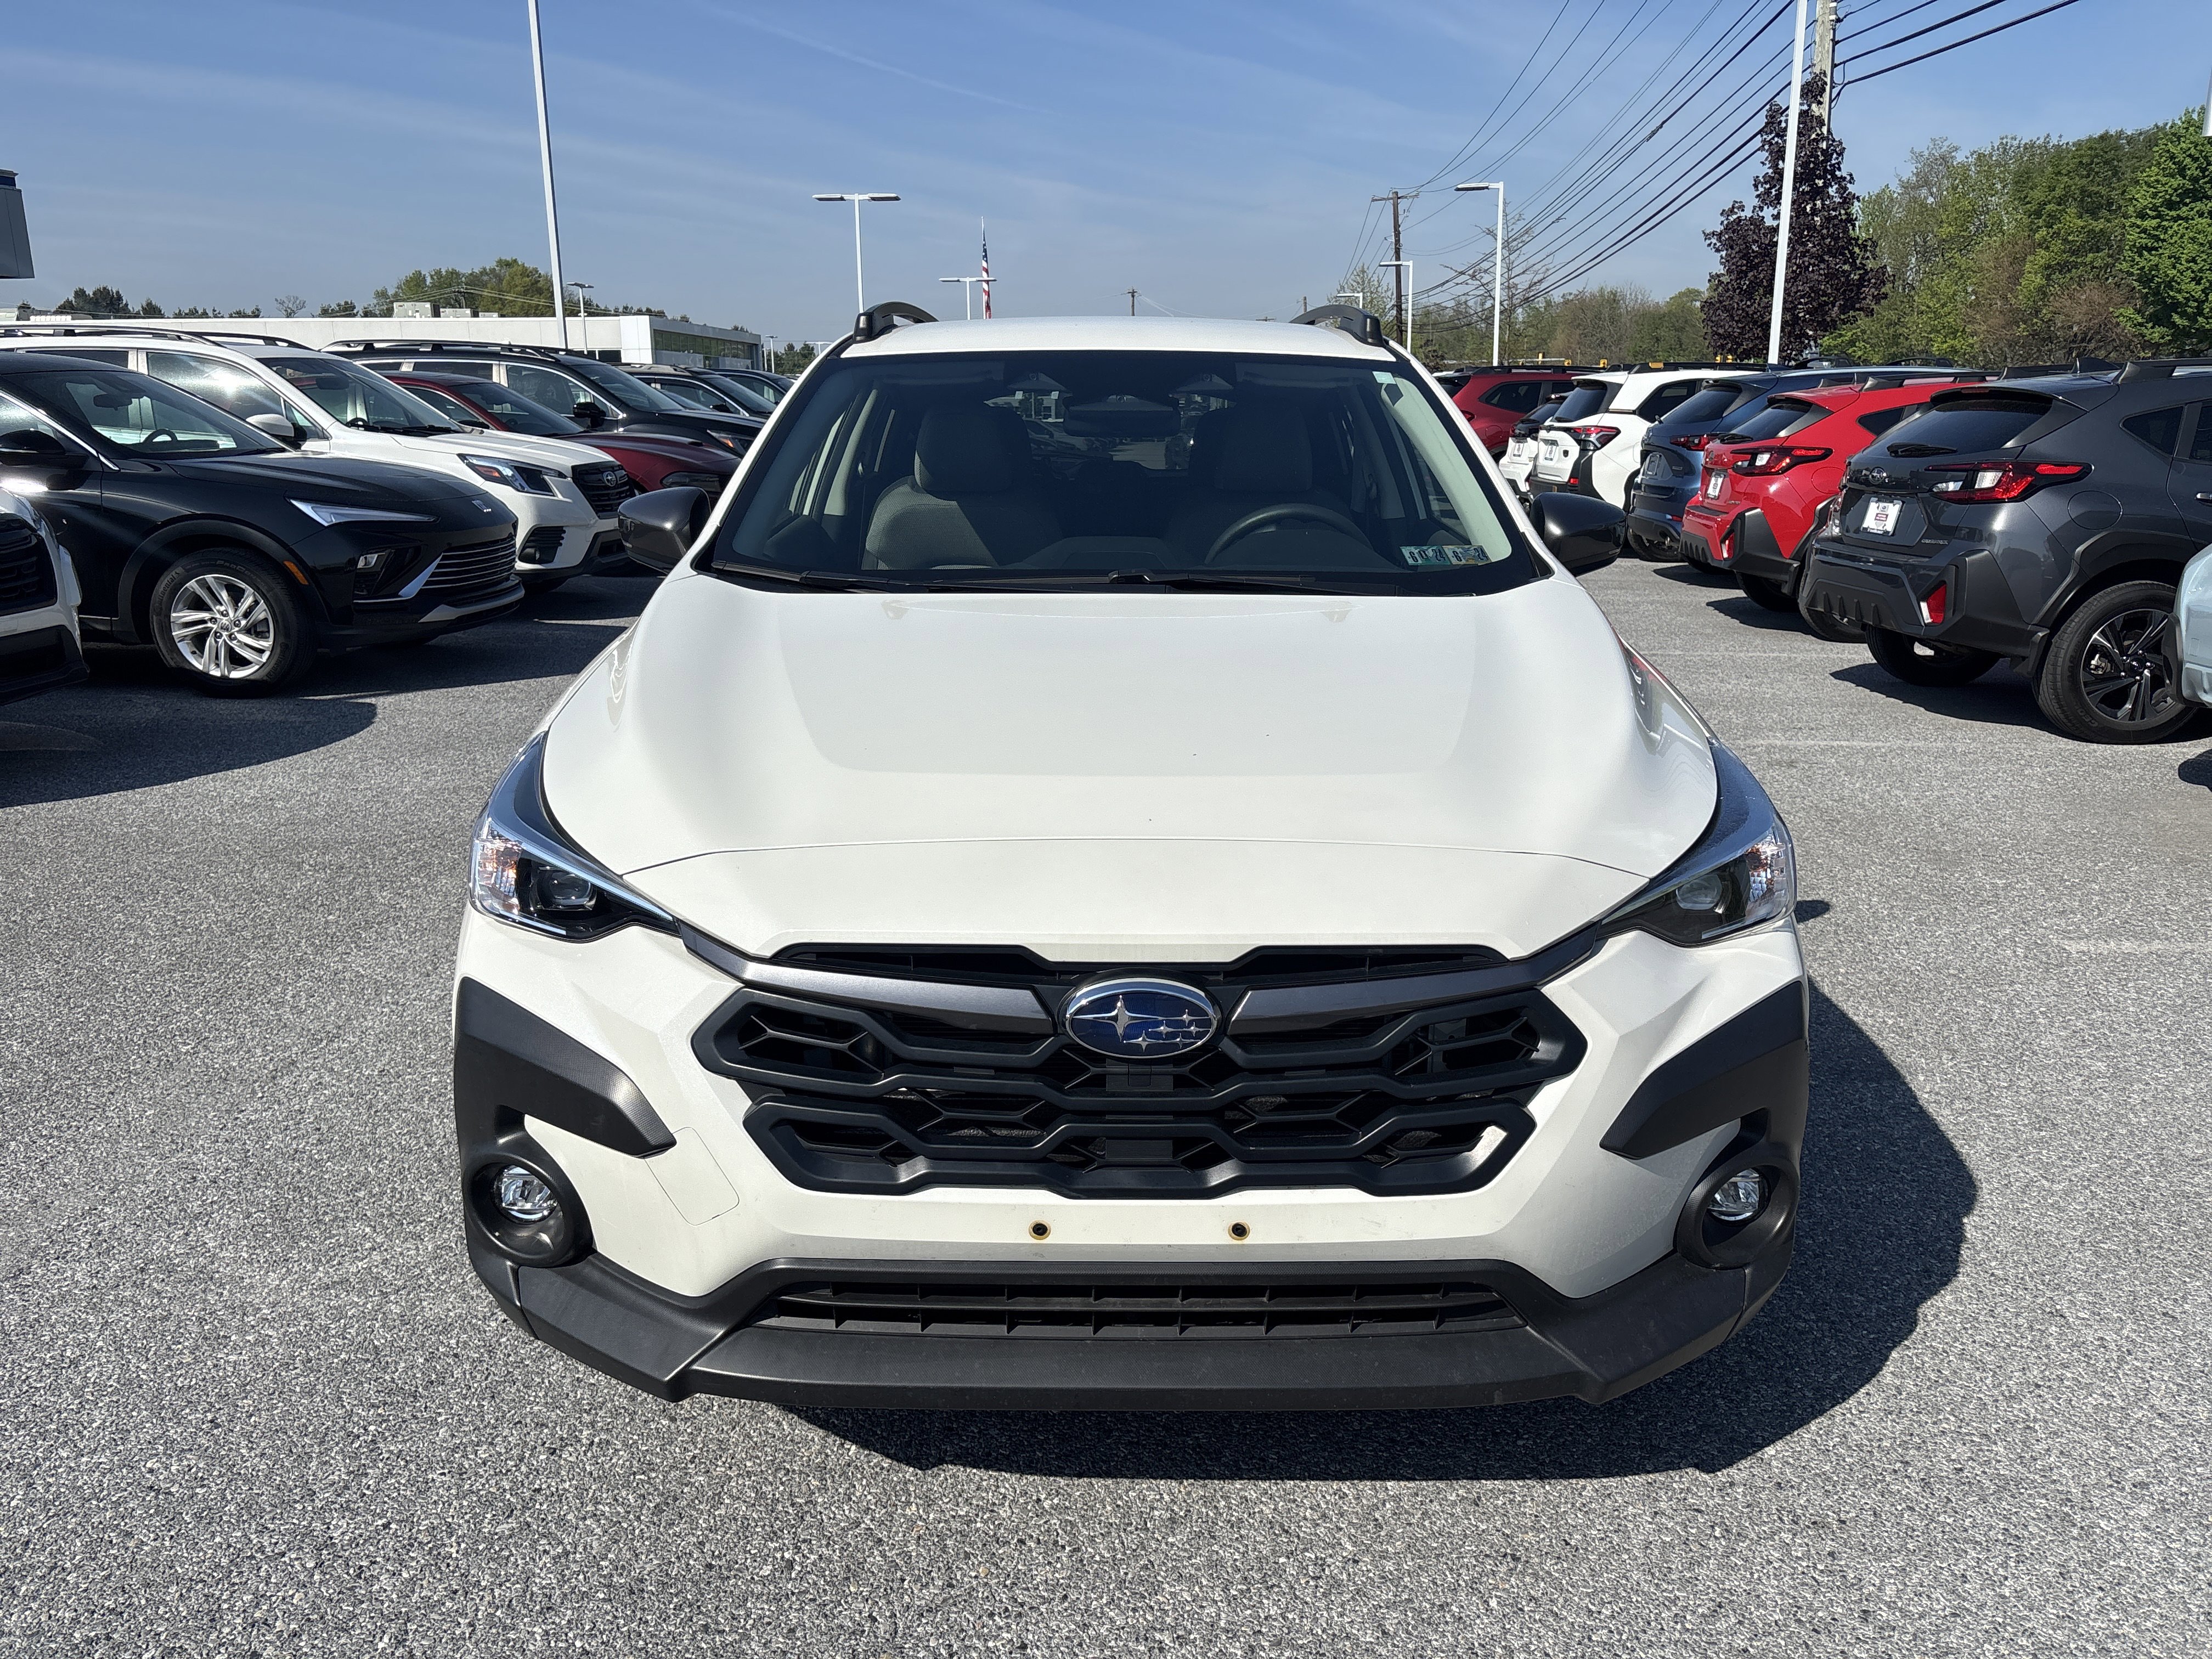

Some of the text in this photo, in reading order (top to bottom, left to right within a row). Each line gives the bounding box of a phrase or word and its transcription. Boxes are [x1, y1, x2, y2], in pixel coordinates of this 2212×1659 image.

[1409, 551, 1419, 562] 6
[1431, 549, 1446, 561] 24
[1453, 551, 1463, 562] 6
[154, 573, 176, 617] tinental
